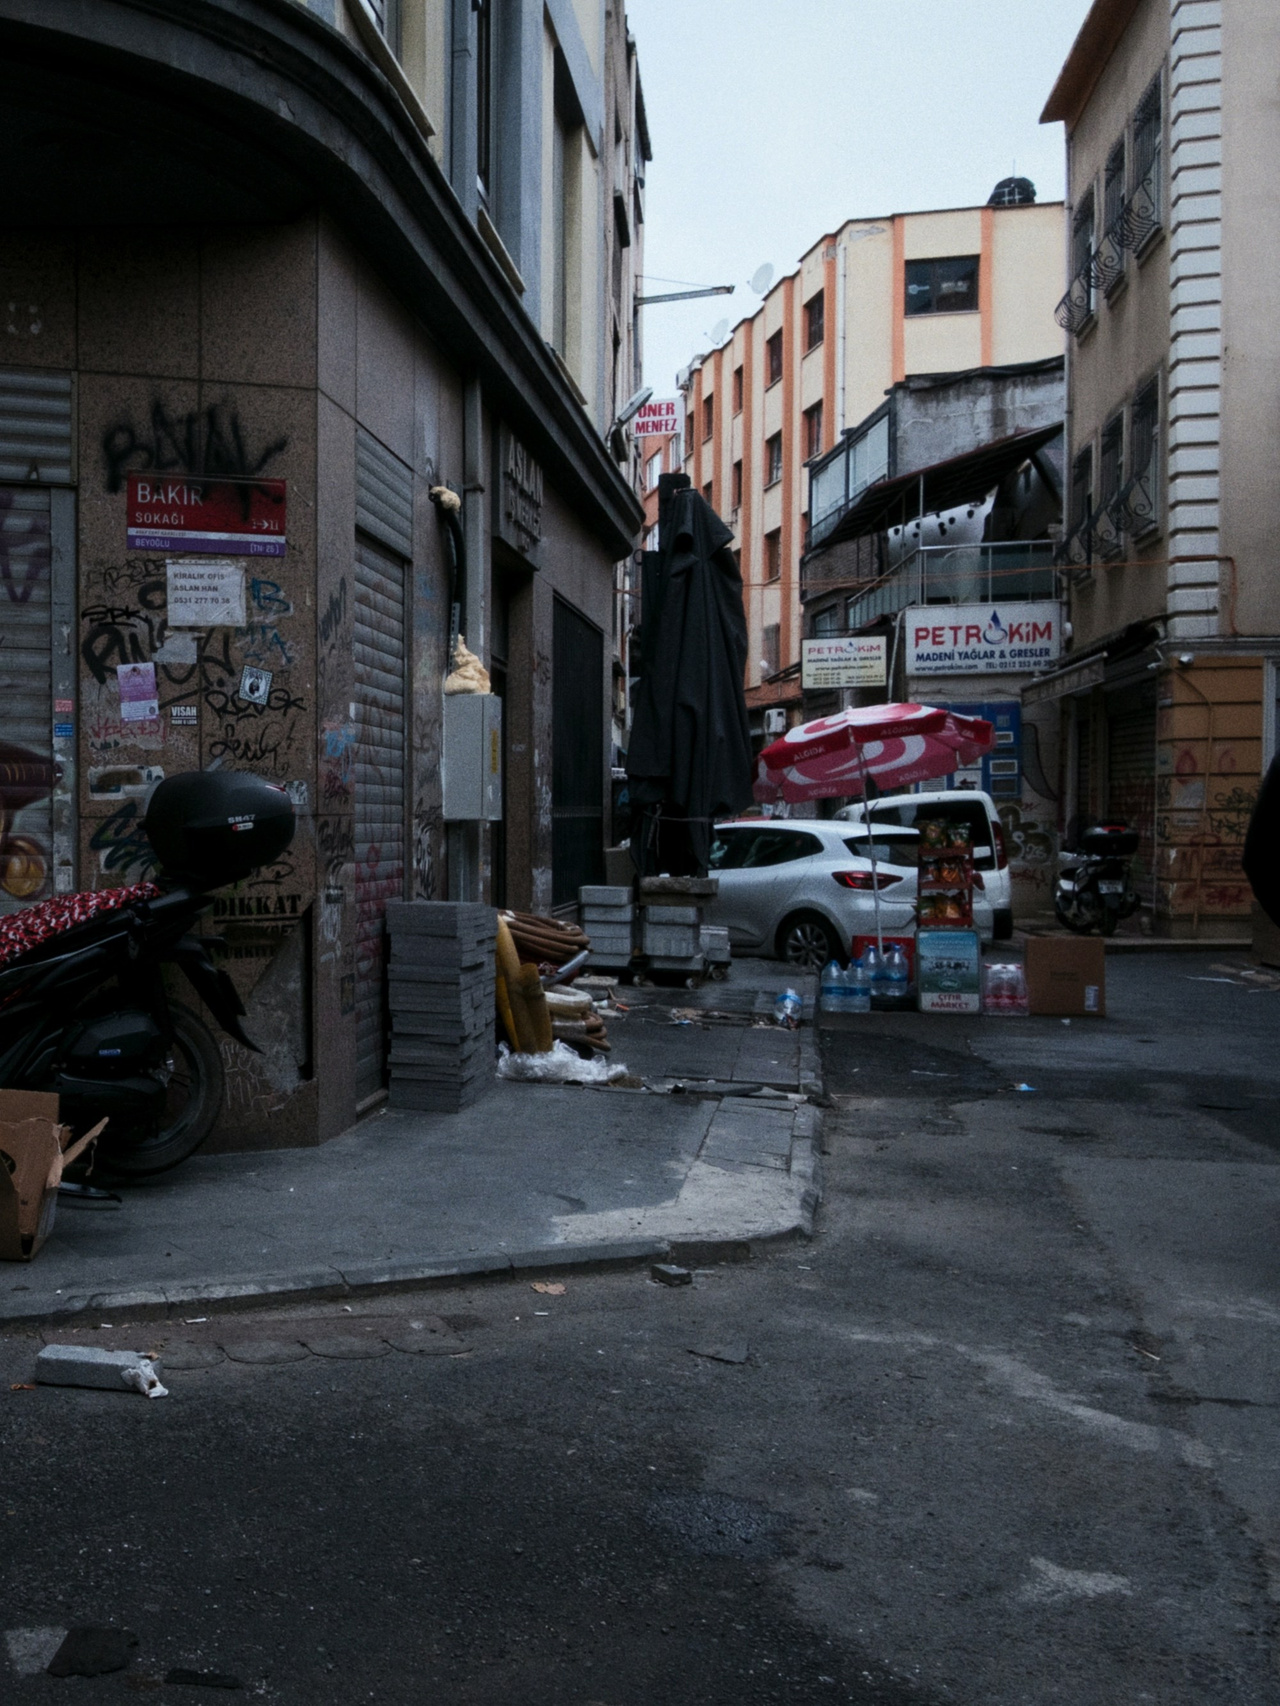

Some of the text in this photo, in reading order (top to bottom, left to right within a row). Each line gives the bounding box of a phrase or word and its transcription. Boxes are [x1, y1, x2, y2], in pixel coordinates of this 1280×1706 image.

[636, 419, 677, 434] MENFEZ
[137, 482, 203, 507] BAKIR
[135, 512, 185, 525] SOKAĞI
[135, 538, 170, 548] BEYOĞLU
[916, 648, 1051, 662] MADENİ YAĞLAR & GRESLER
[171, 705, 197, 717] VISAH
[881, 726, 915, 736] ALGIDA
[794, 745, 825, 761] ALGIDA
